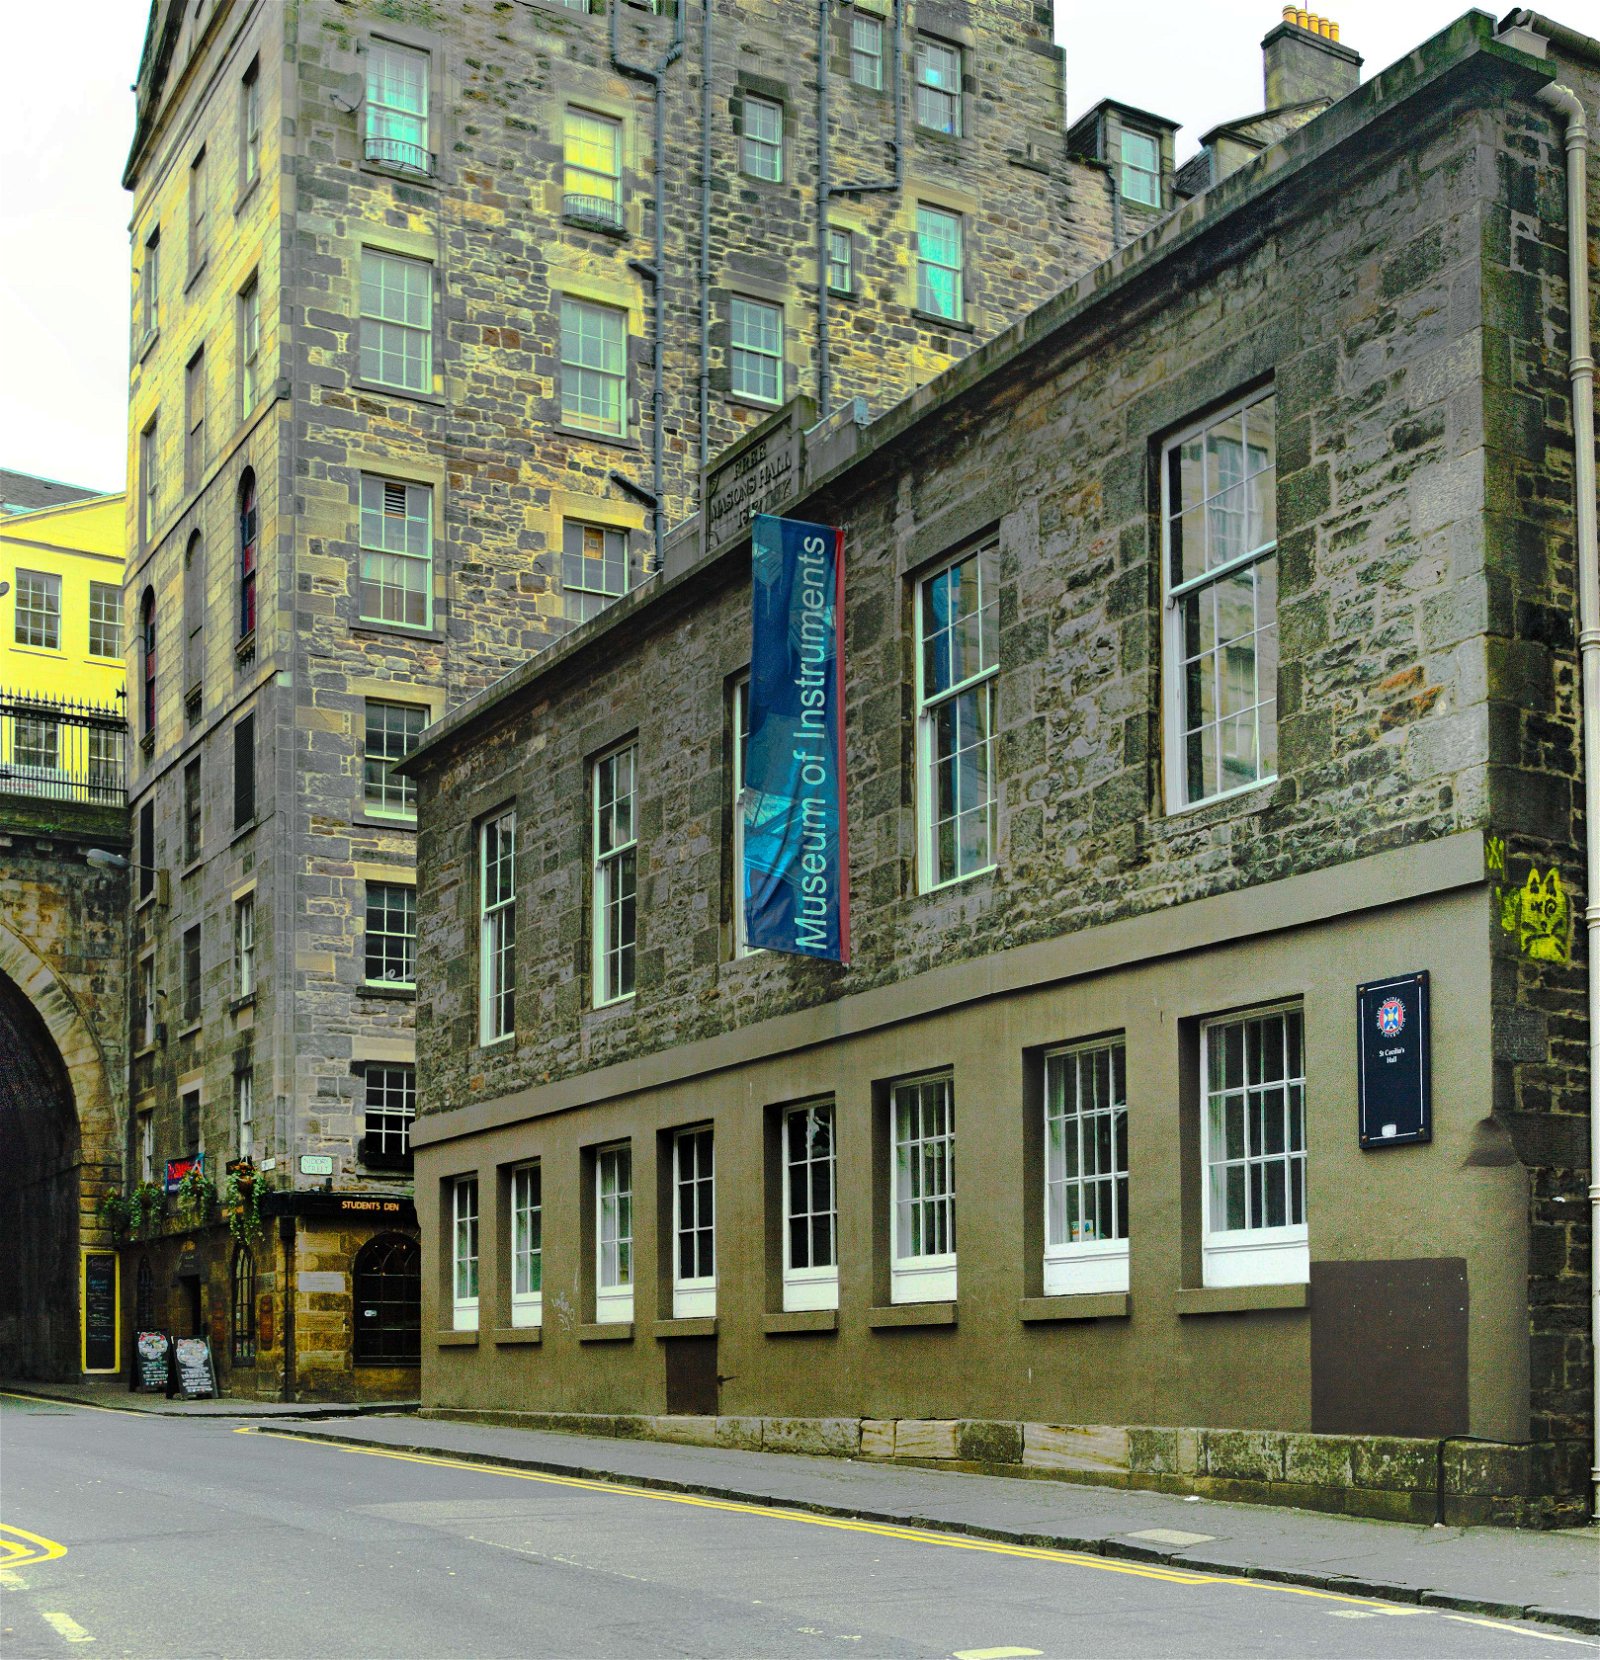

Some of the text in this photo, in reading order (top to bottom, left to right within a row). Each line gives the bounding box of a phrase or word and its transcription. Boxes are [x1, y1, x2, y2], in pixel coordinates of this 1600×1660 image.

[734, 443, 766, 481] FREE
[710, 452, 792, 523] MASONS HALL
[793, 536, 827, 950] Museum of Instruments
[1386, 1055, 1397, 1063] Hall
[383, 1202, 400, 1211] DEN
